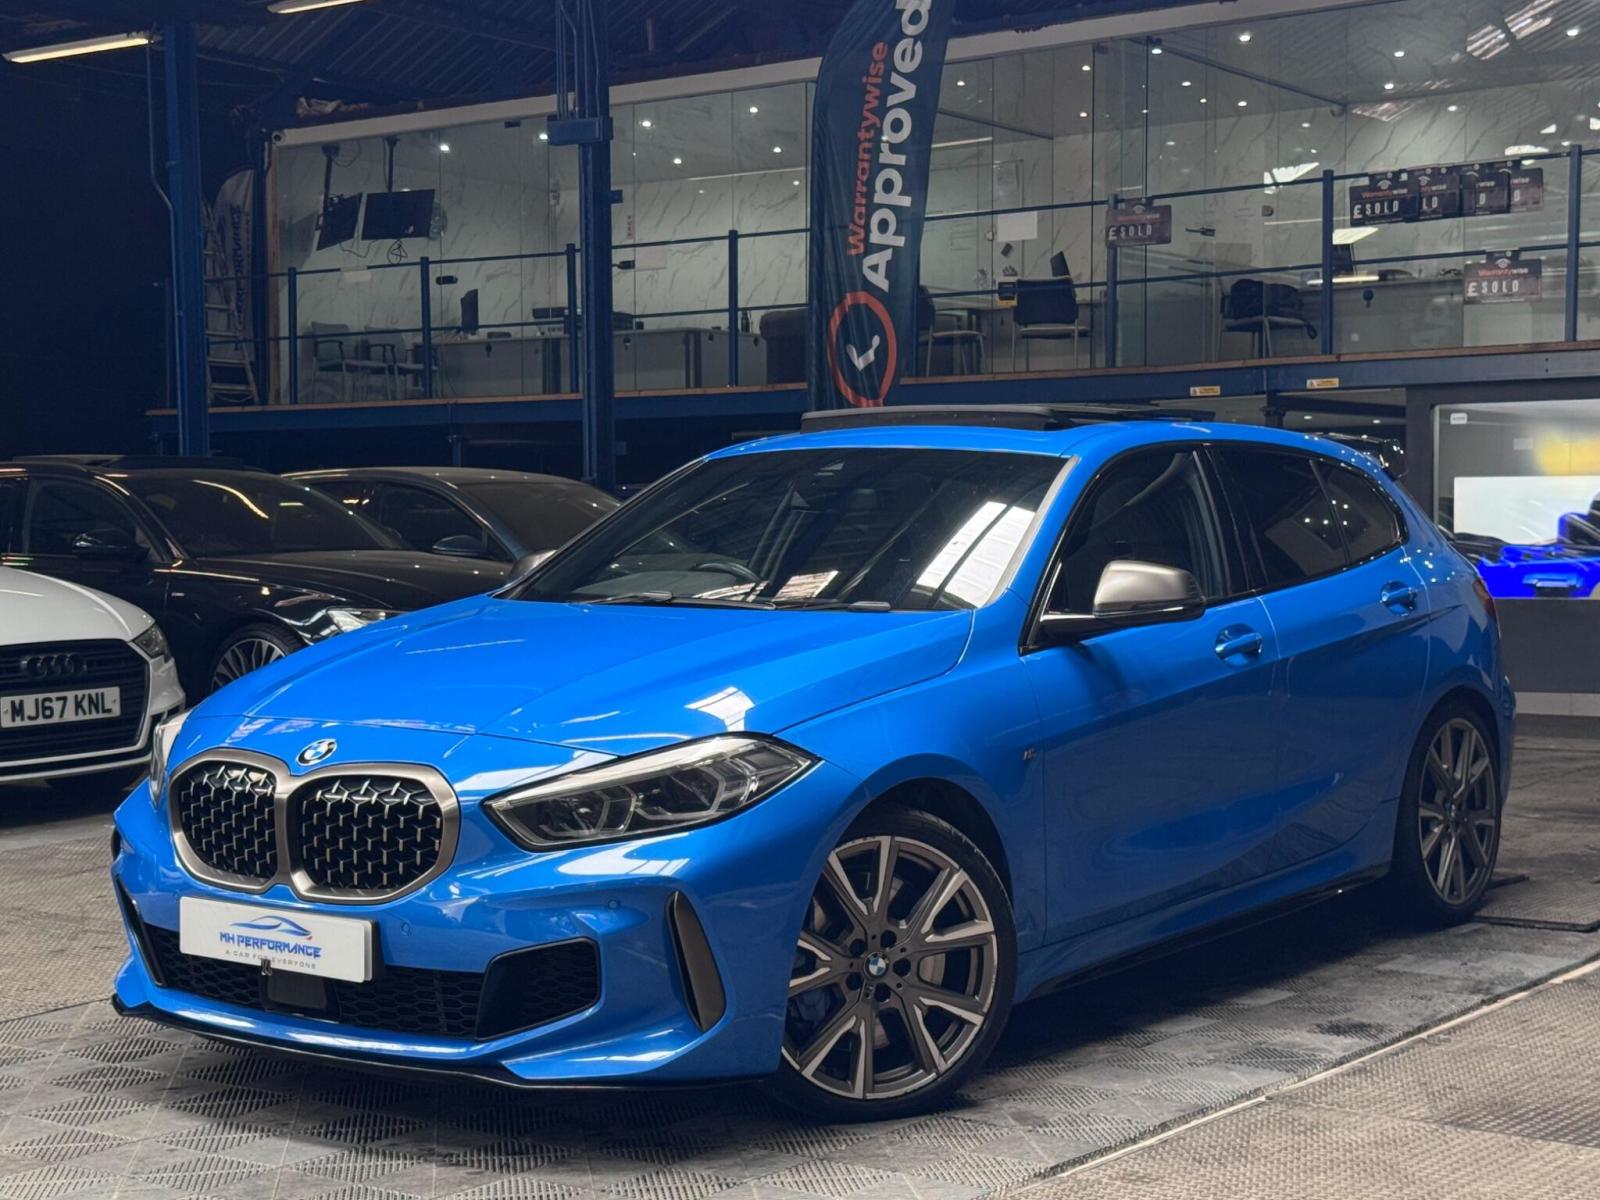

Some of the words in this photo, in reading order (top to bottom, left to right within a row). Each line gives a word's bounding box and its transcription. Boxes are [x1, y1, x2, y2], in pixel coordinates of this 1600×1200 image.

[847, 41, 888, 255] Warrantywise
[862, 0, 932, 293] Approved
[10, 696, 67, 722] MJ67
[74, 692, 112, 716] KNL
[219, 931, 235, 944] MH
[236, 935, 322, 957] PERFORMANCE
[272, 957, 316, 969] EVERYONE
